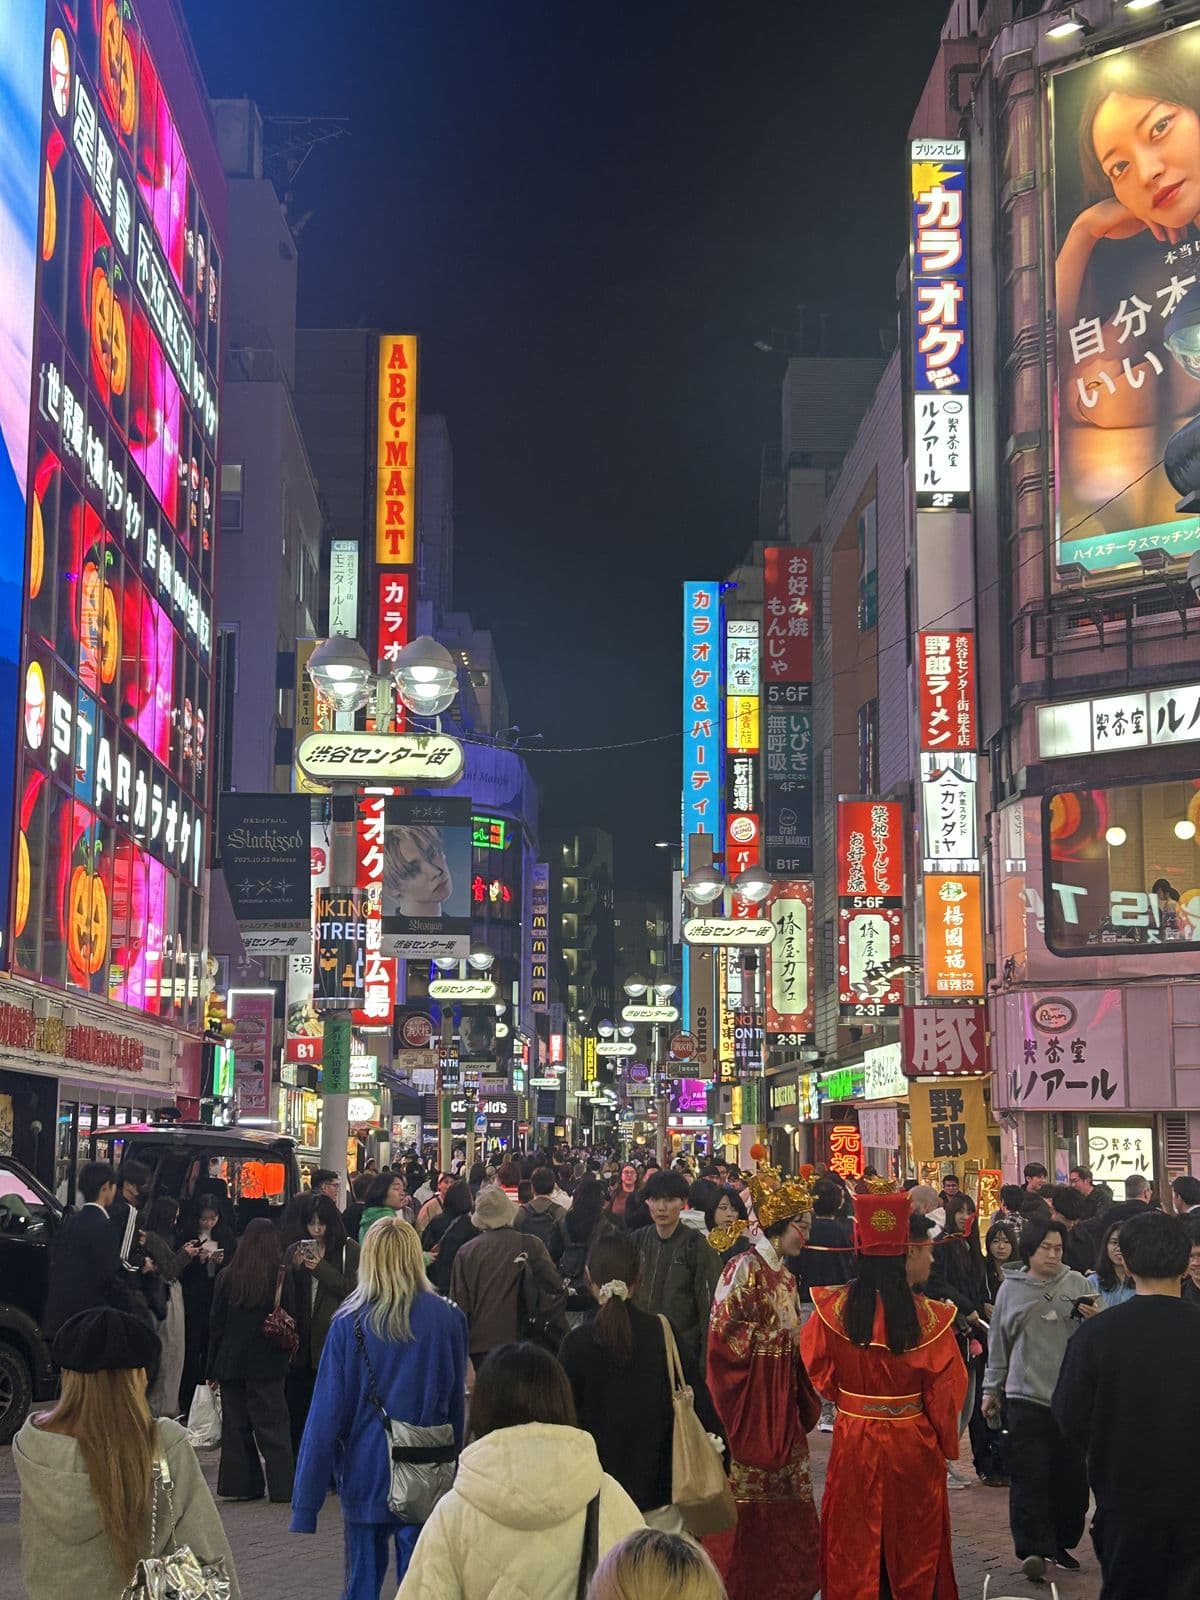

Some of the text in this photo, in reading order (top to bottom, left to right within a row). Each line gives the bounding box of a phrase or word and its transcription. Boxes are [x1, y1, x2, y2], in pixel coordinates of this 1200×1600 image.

[915, 144, 961, 156] プリンスビル
[917, 184, 964, 369] カラオケ
[1076, 350, 1164, 409] いい
[921, 401, 941, 486] ルノアール
[946, 417, 960, 468] 喫茶室
[932, 493, 954, 506] 2F
[788, 556, 809, 637] お好み焼
[766, 597, 789, 676] もんじゃ
[734, 647, 752, 686] 麻雀
[924, 635, 952, 746] 野郎ラーメン
[767, 715, 788, 772] 無呼吸
[790, 715, 811, 772] いびき
[1096, 707, 1144, 739] 喫茶室
[305, 745, 453, 766] 渋谷センター街
[940, 790, 957, 853] カンダヤ
[776, 859, 800, 870] B1F
[847, 832, 866, 893] お好み焼
[871, 805, 890, 894] 築地もんじゃ
[394, 940, 457, 950] 渋谷センター街
[688, 924, 773, 937] 渋谷センター街
[431, 985, 493, 994] 渋谷センター街
[297, 1043, 315, 1058] B1
[911, 1008, 979, 1071] 豚
[1023, 1036, 1087, 1065] 喫茶室
[928, 1088, 968, 1159] 野郎
[1111, 1138, 1143, 1151] 喫茶室
